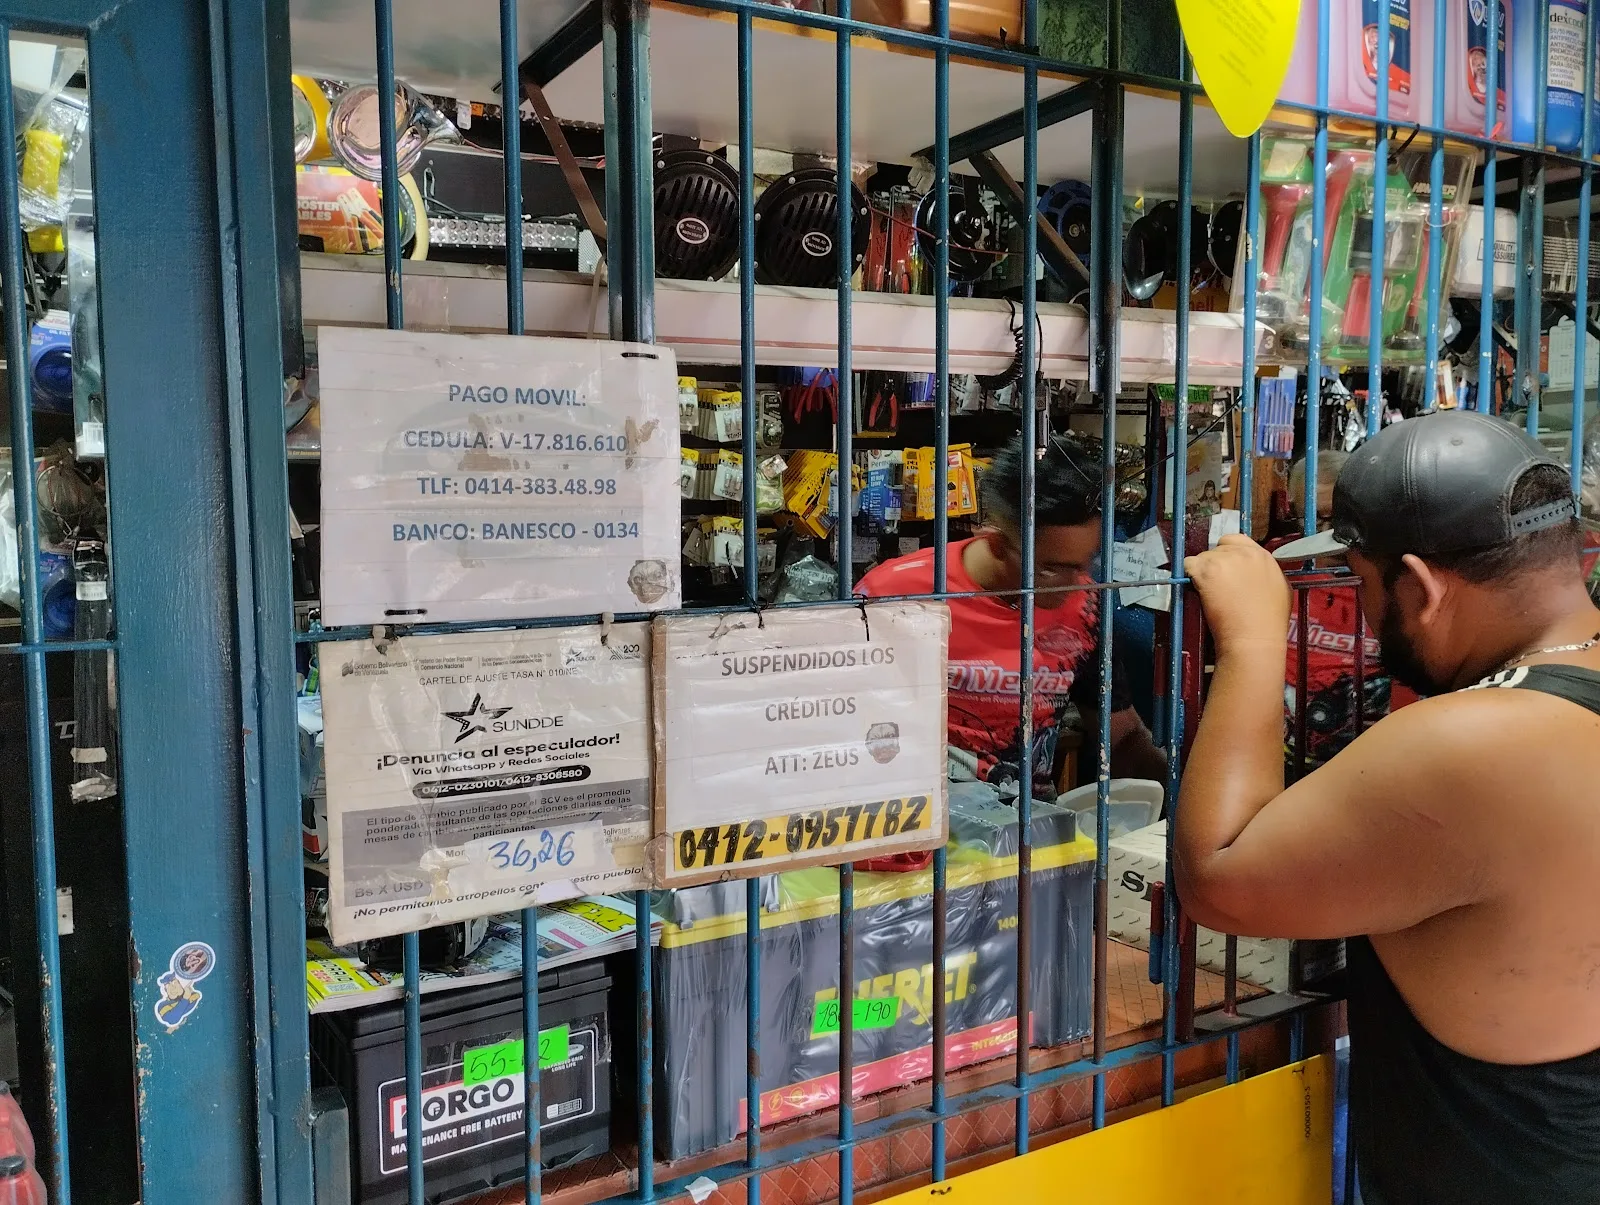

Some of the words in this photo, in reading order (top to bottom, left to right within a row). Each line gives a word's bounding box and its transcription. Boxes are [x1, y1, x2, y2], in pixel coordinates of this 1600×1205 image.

[1412, 182, 1458, 196] HAMER
[297, 210, 332, 221] ABLES
[449, 384, 508, 405] PAGO
[515, 387, 587, 407] MOVIL:
[404, 430, 494, 449] CEDULA:
[500, 433, 627, 451] V-17.816.610
[417, 477, 458, 495] TLF:
[464, 477, 617, 496] 0414-383.48.98
[393, 523, 475, 541] BANCO:
[482, 522, 576, 540] BANESCO
[594, 522, 640, 538] 0134
[721, 650, 856, 677] SUSPENDIDOS
[862, 647, 895, 666] LOS
[419, 676, 455, 686] CARTEL
[460, 675, 472, 684] DE
[510, 671, 534, 681] TASA
[765, 697, 856, 722] CRÉDITOS
[492, 715, 564, 733] SUNDDE
[481, 745, 499, 758] al
[503, 733, 620, 757] especulador!
[435, 760, 496, 775] Whatsapp
[499, 760, 506, 770] y
[508, 756, 542, 768] Redes
[545, 751, 590, 763] Sociales
[765, 756, 807, 775] ATT:
[813, 748, 859, 769] ZEUS
[367, 817, 377, 826] El
[381, 815, 401, 826] tipo
[459, 803, 508, 816] publicado
[511, 801, 526, 811] por
[540, 796, 560, 805] BCV
[587, 789, 631, 801] promedio
[493, 811, 508, 819] las
[571, 800, 602, 809] diarias
[364, 833, 399, 843] mesas
[473, 824, 536, 840] participantes
[488, 829, 576, 872] 36,26
[355, 887, 374, 898] Bs
[379, 885, 388, 895] X
[394, 881, 423, 893] USD
[353, 908, 376, 919] ¡No
[456, 885, 516, 902] atropellos
[818, 1001, 891, 1028] 18-190
[470, 1038, 551, 1081] 55-2
[400, 1078, 515, 1128] ORGO
[391, 1128, 457, 1156] MAENANCE
[460, 1121, 482, 1135] FREE
[484, 1110, 523, 1129] BATTERY
